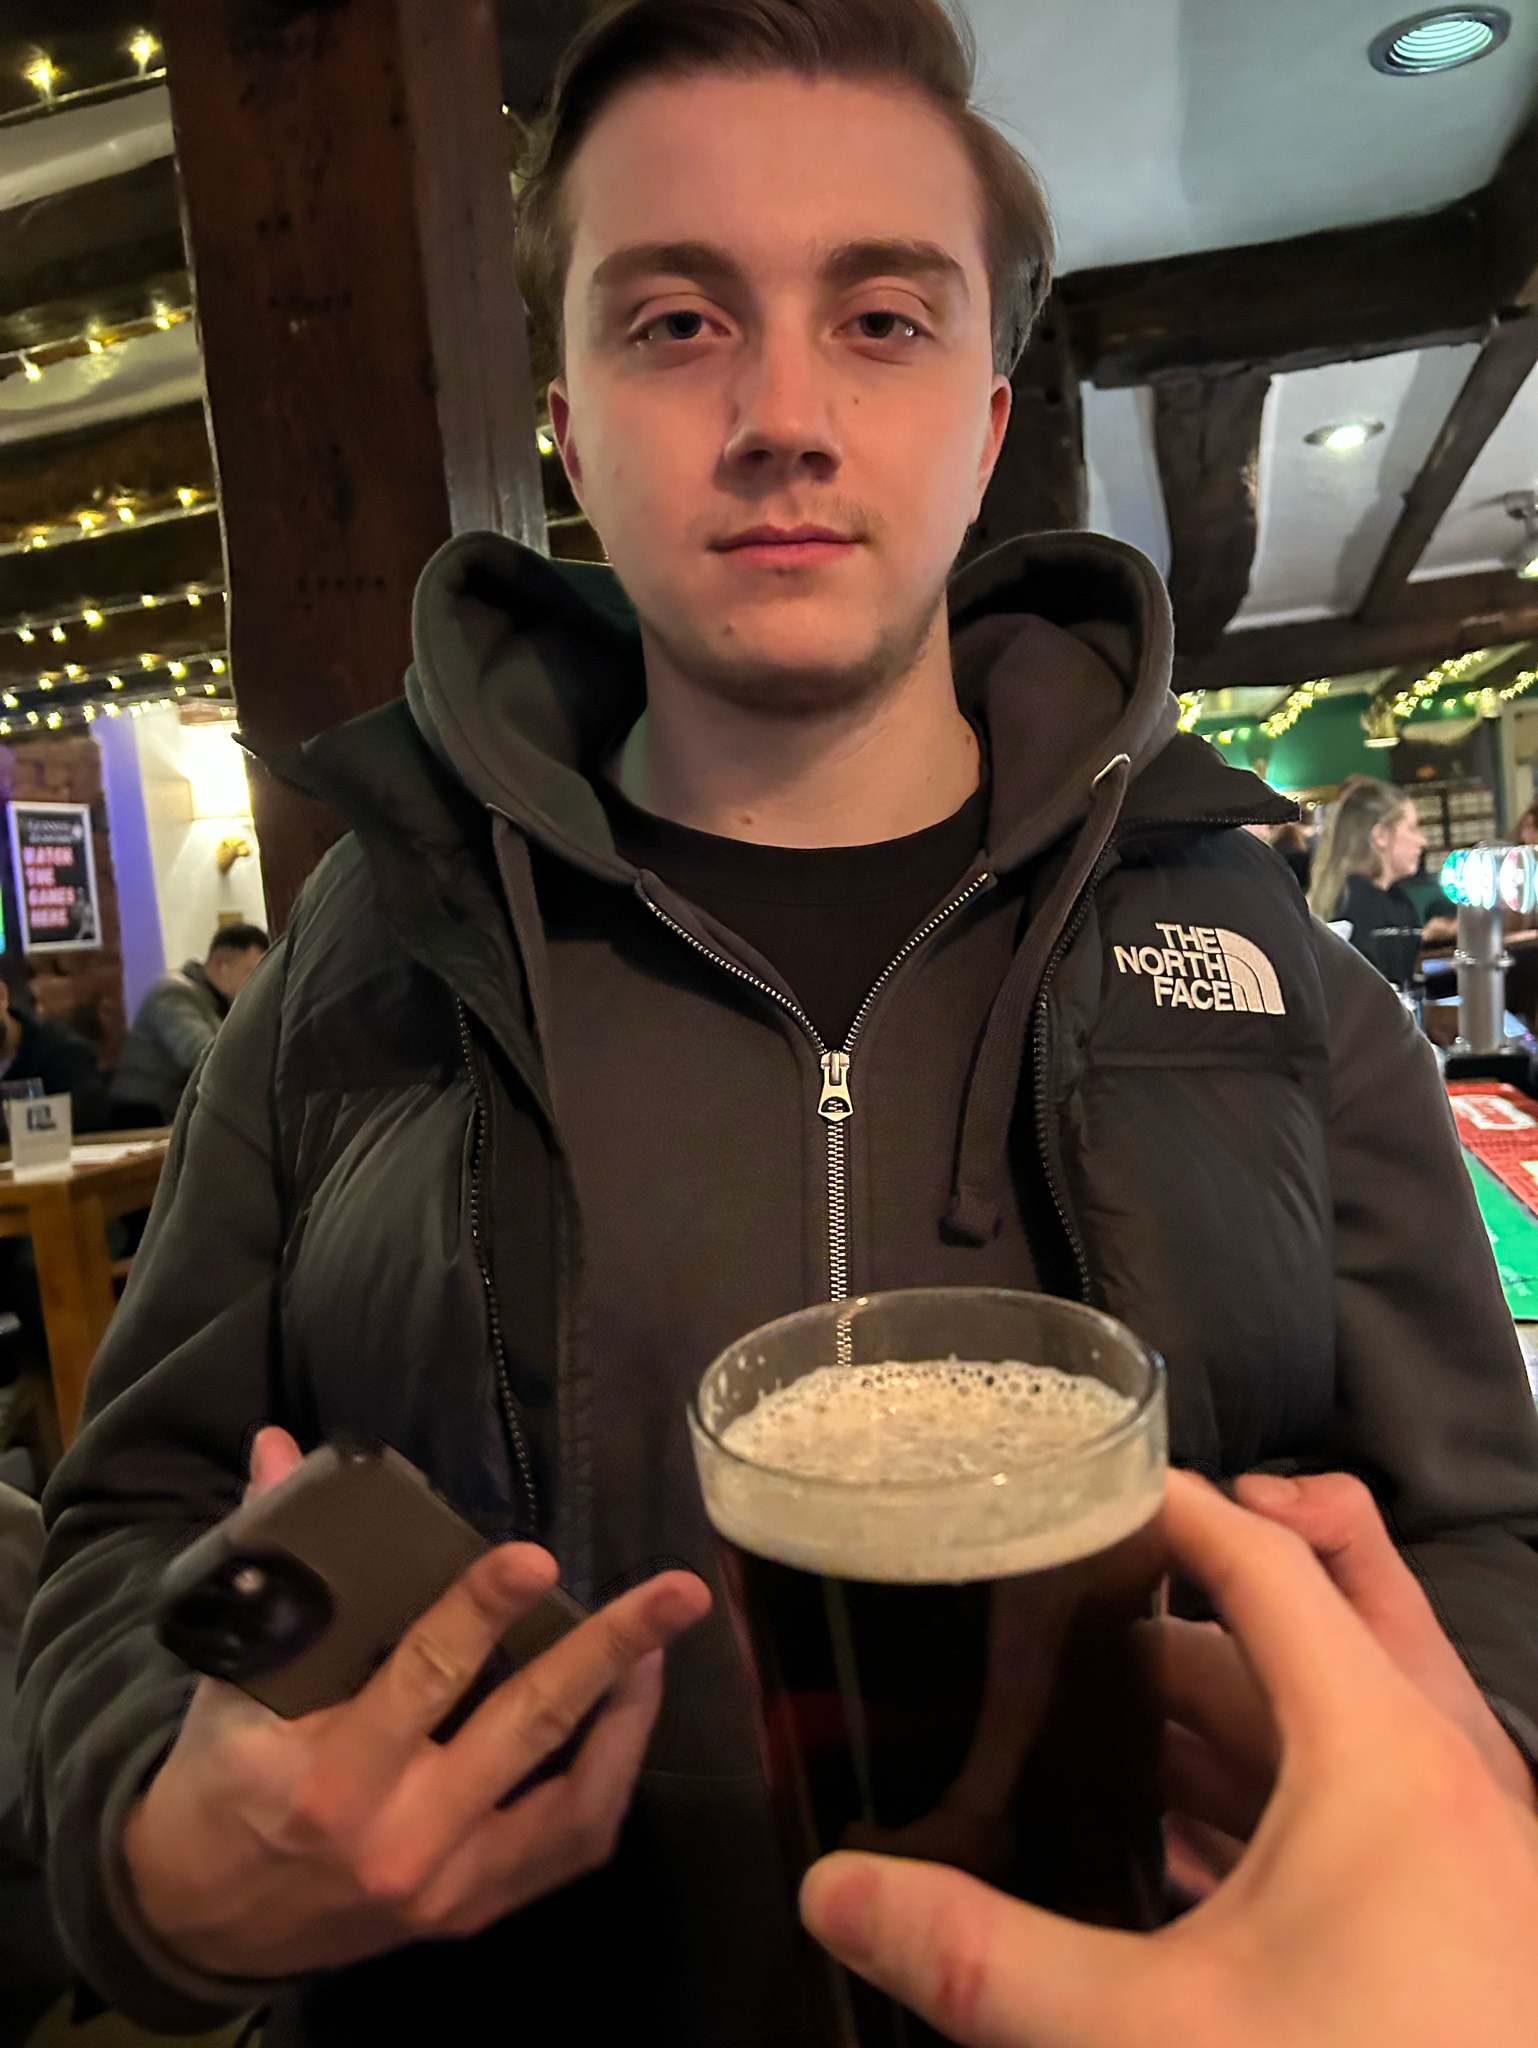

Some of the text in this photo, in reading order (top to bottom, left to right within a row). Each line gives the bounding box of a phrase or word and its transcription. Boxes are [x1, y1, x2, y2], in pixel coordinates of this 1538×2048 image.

[1155, 922, 1222, 953] THE
[1113, 945, 1228, 981] NORTH
[1153, 975, 1234, 1012] FACE
